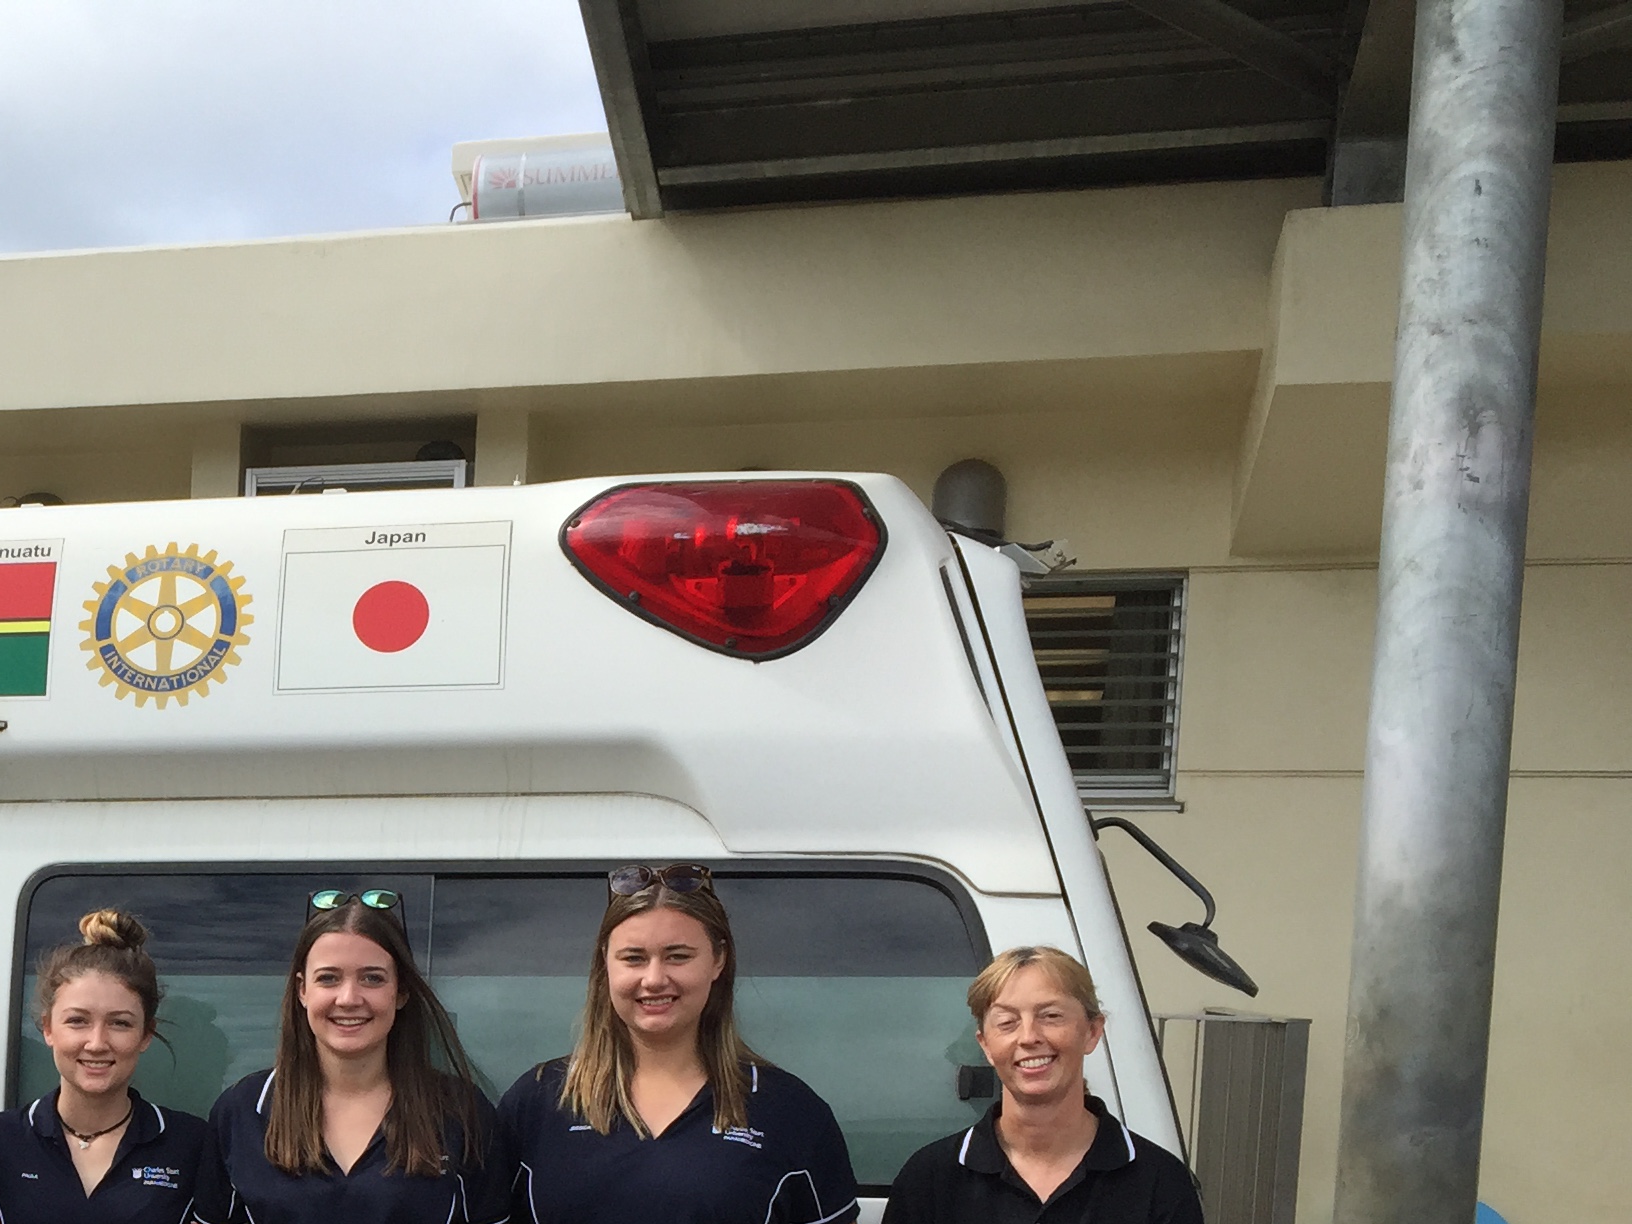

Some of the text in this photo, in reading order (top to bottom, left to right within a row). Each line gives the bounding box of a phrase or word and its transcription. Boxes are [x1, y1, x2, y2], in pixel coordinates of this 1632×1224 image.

[522, 163, 621, 186] SUMME
[364, 531, 426, 547] Japan
[135, 557, 208, 578] ROTARY
[104, 646, 227, 691] INTERNATIONAL
